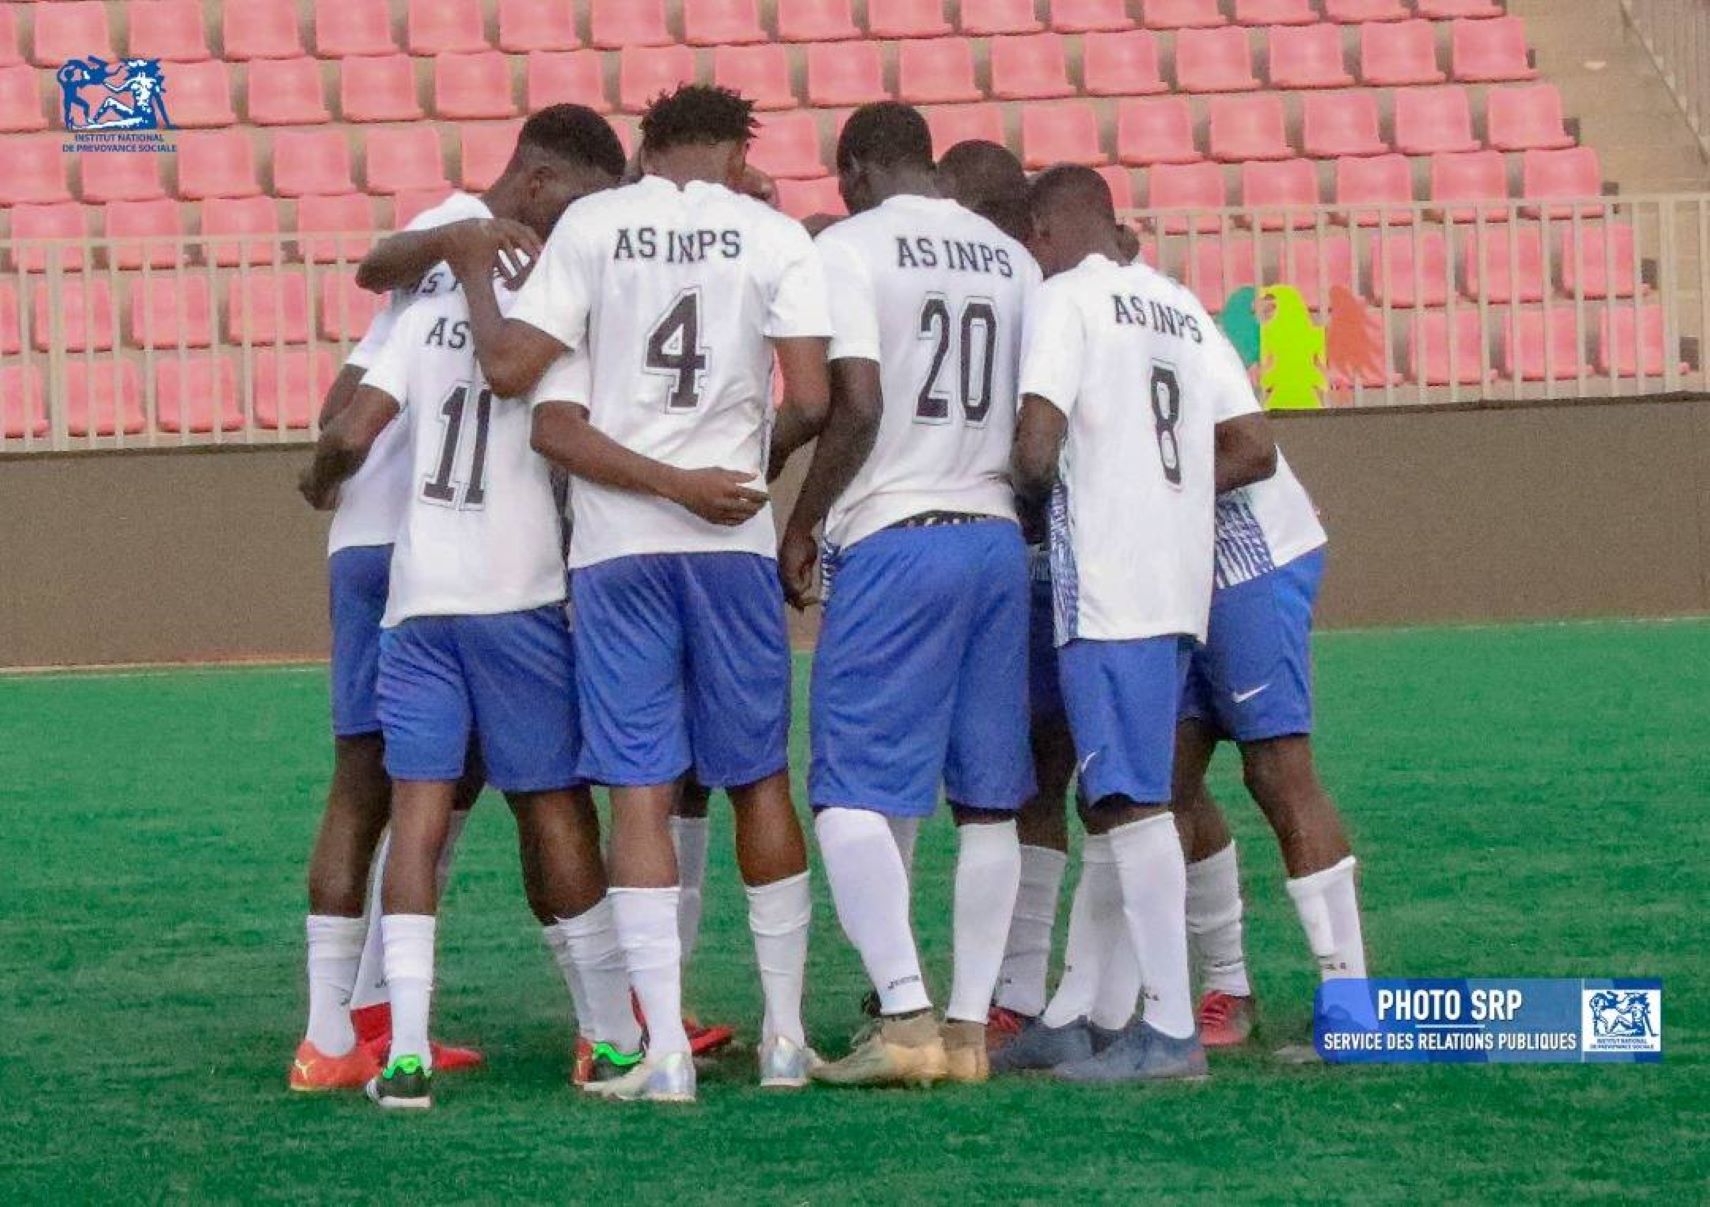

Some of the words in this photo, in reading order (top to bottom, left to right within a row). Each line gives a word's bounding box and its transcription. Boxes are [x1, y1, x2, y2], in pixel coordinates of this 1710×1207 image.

[613, 227, 657, 260] AS
[665, 229, 741, 264] INPS
[895, 236, 938, 269] AS
[941, 239, 1014, 279] INPS
[425, 316, 470, 350] AS
[641, 284, 713, 415] 4
[912, 290, 999, 430] 20
[1111, 294, 1147, 327] AS
[1148, 299, 1204, 345] INPS
[418, 379, 494, 512] 11
[1149, 356, 1184, 493] 8
